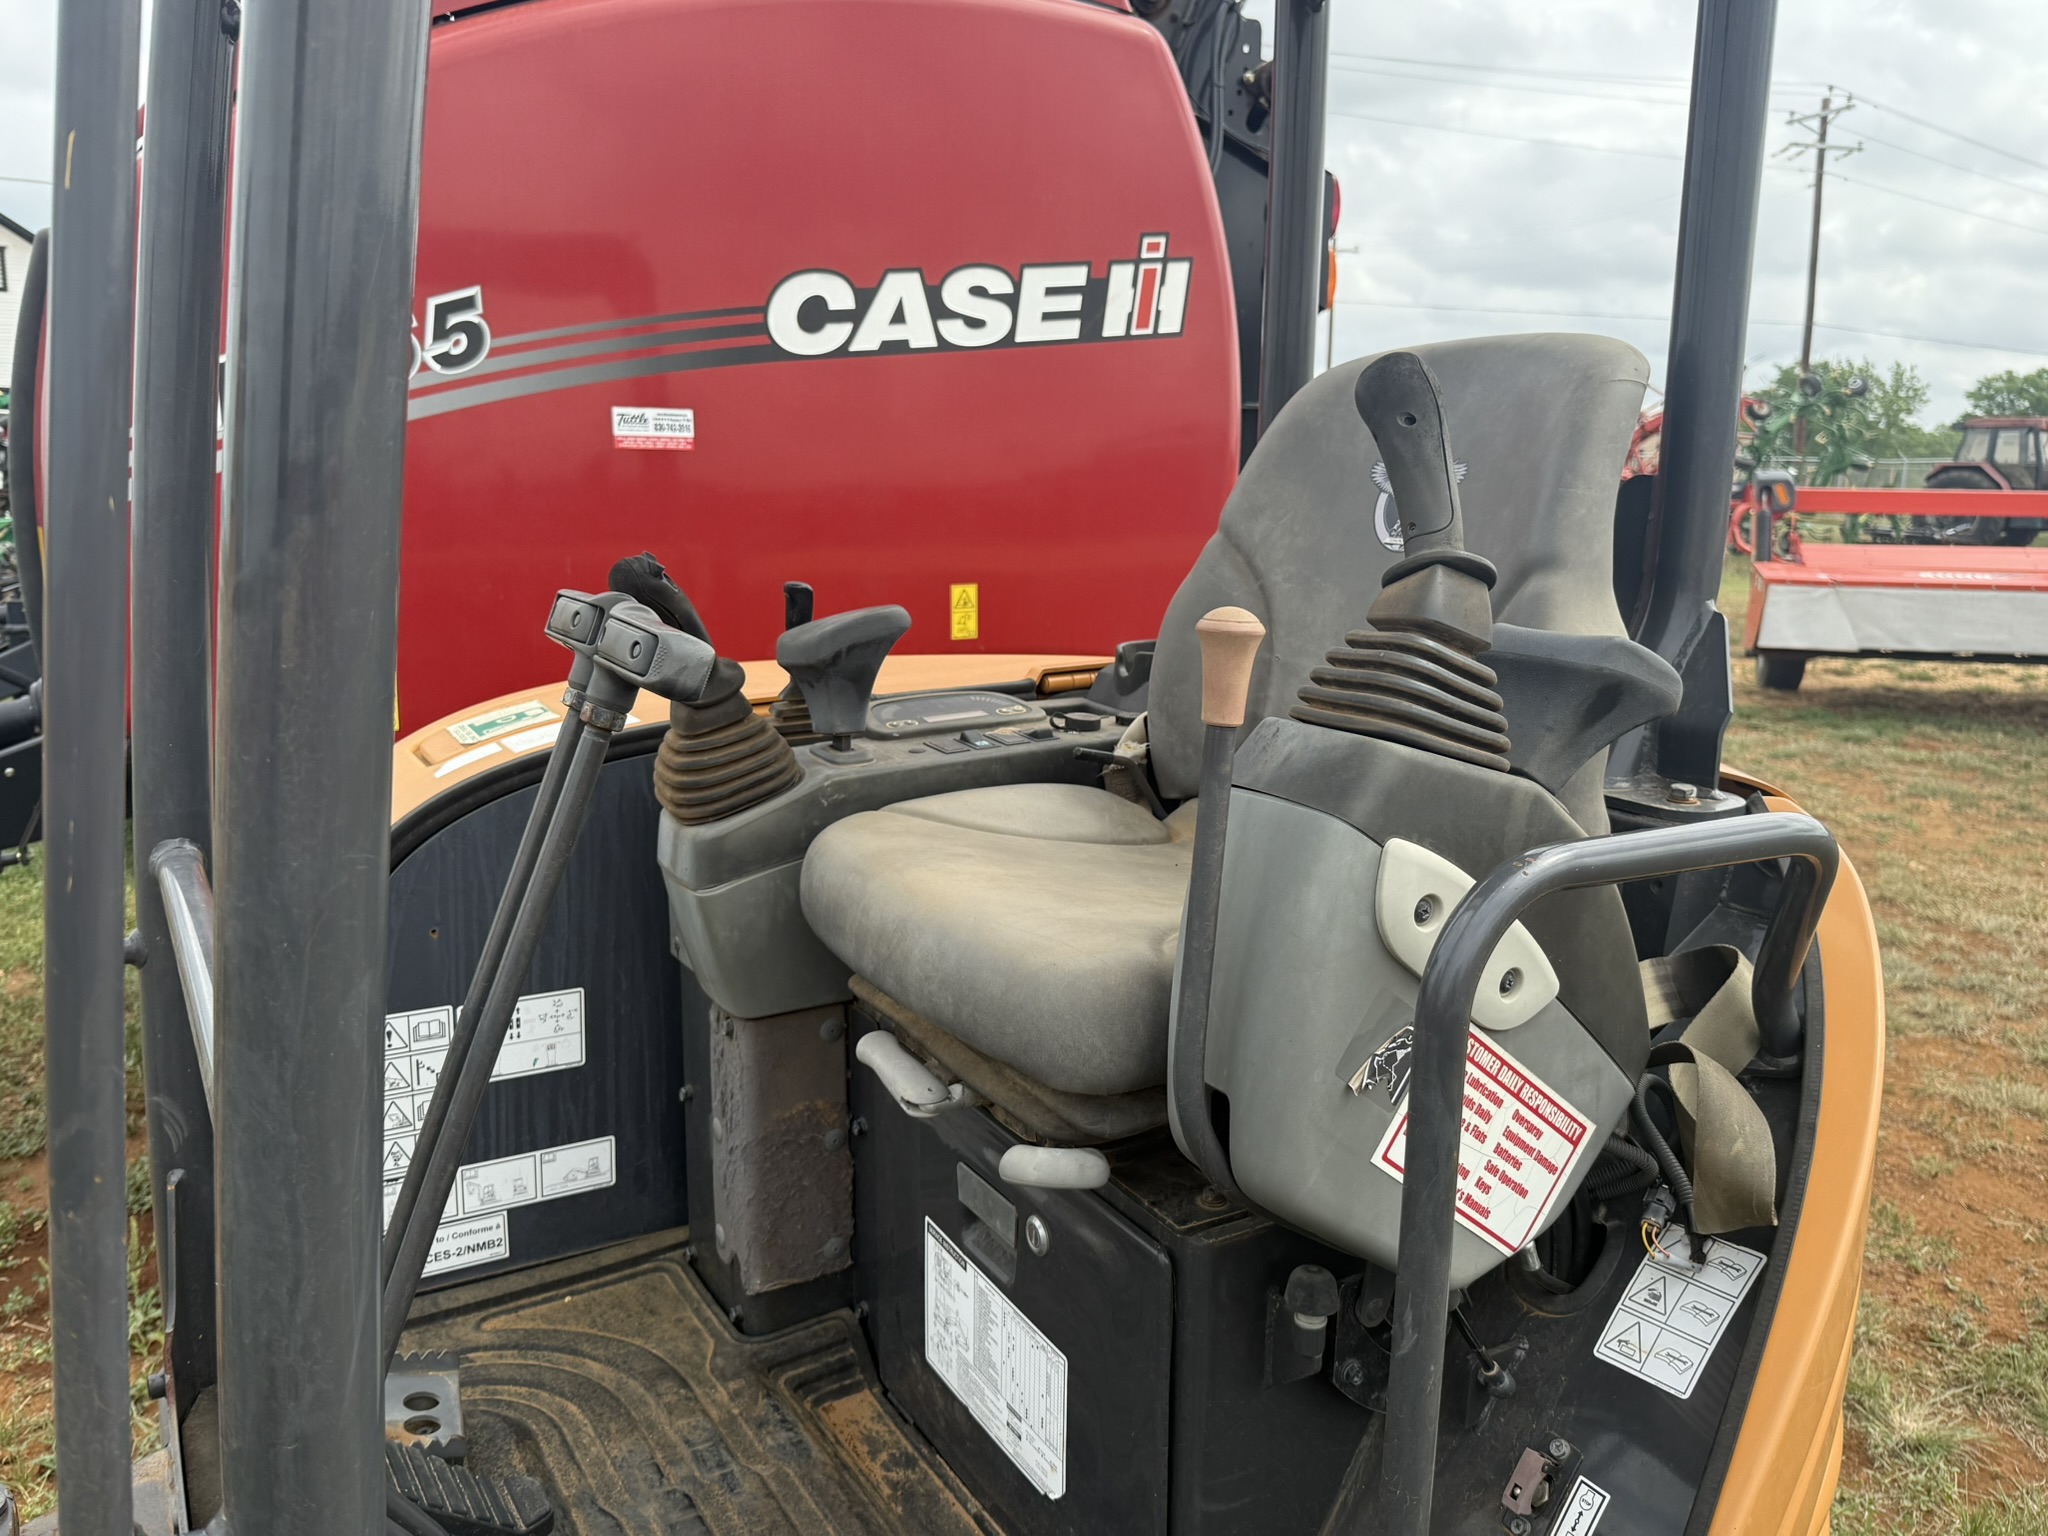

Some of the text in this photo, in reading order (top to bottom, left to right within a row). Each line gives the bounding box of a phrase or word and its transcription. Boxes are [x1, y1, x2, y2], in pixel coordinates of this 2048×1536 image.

[767, 262, 1090, 356] CASE
[616, 412, 650, 427] Tuttle
[1465, 1071, 1504, 1109] Lubrication
[1467, 1036, 1583, 1141] STOMER DAILY RESPONSIBILITY
[1474, 1102, 1493, 1125] Daily
[1511, 1108, 1544, 1141] Overspray
[1464, 1121, 1472, 1133] &
[1469, 1123, 1488, 1145] Flats
[1493, 1141, 1523, 1172] Batteries
[1502, 1125, 1559, 1176] Equipment Damage
[1474, 1175, 1492, 1196] Keys
[1483, 1158, 1500, 1178] Safe
[1497, 1169, 1529, 1200] Operation
[1462, 1192, 1492, 1220] Manuals
[435, 1236, 445, 1244] to
[451, 1224, 494, 1240] Conforme
[426, 1237, 504, 1264] CES-2/NMB2
